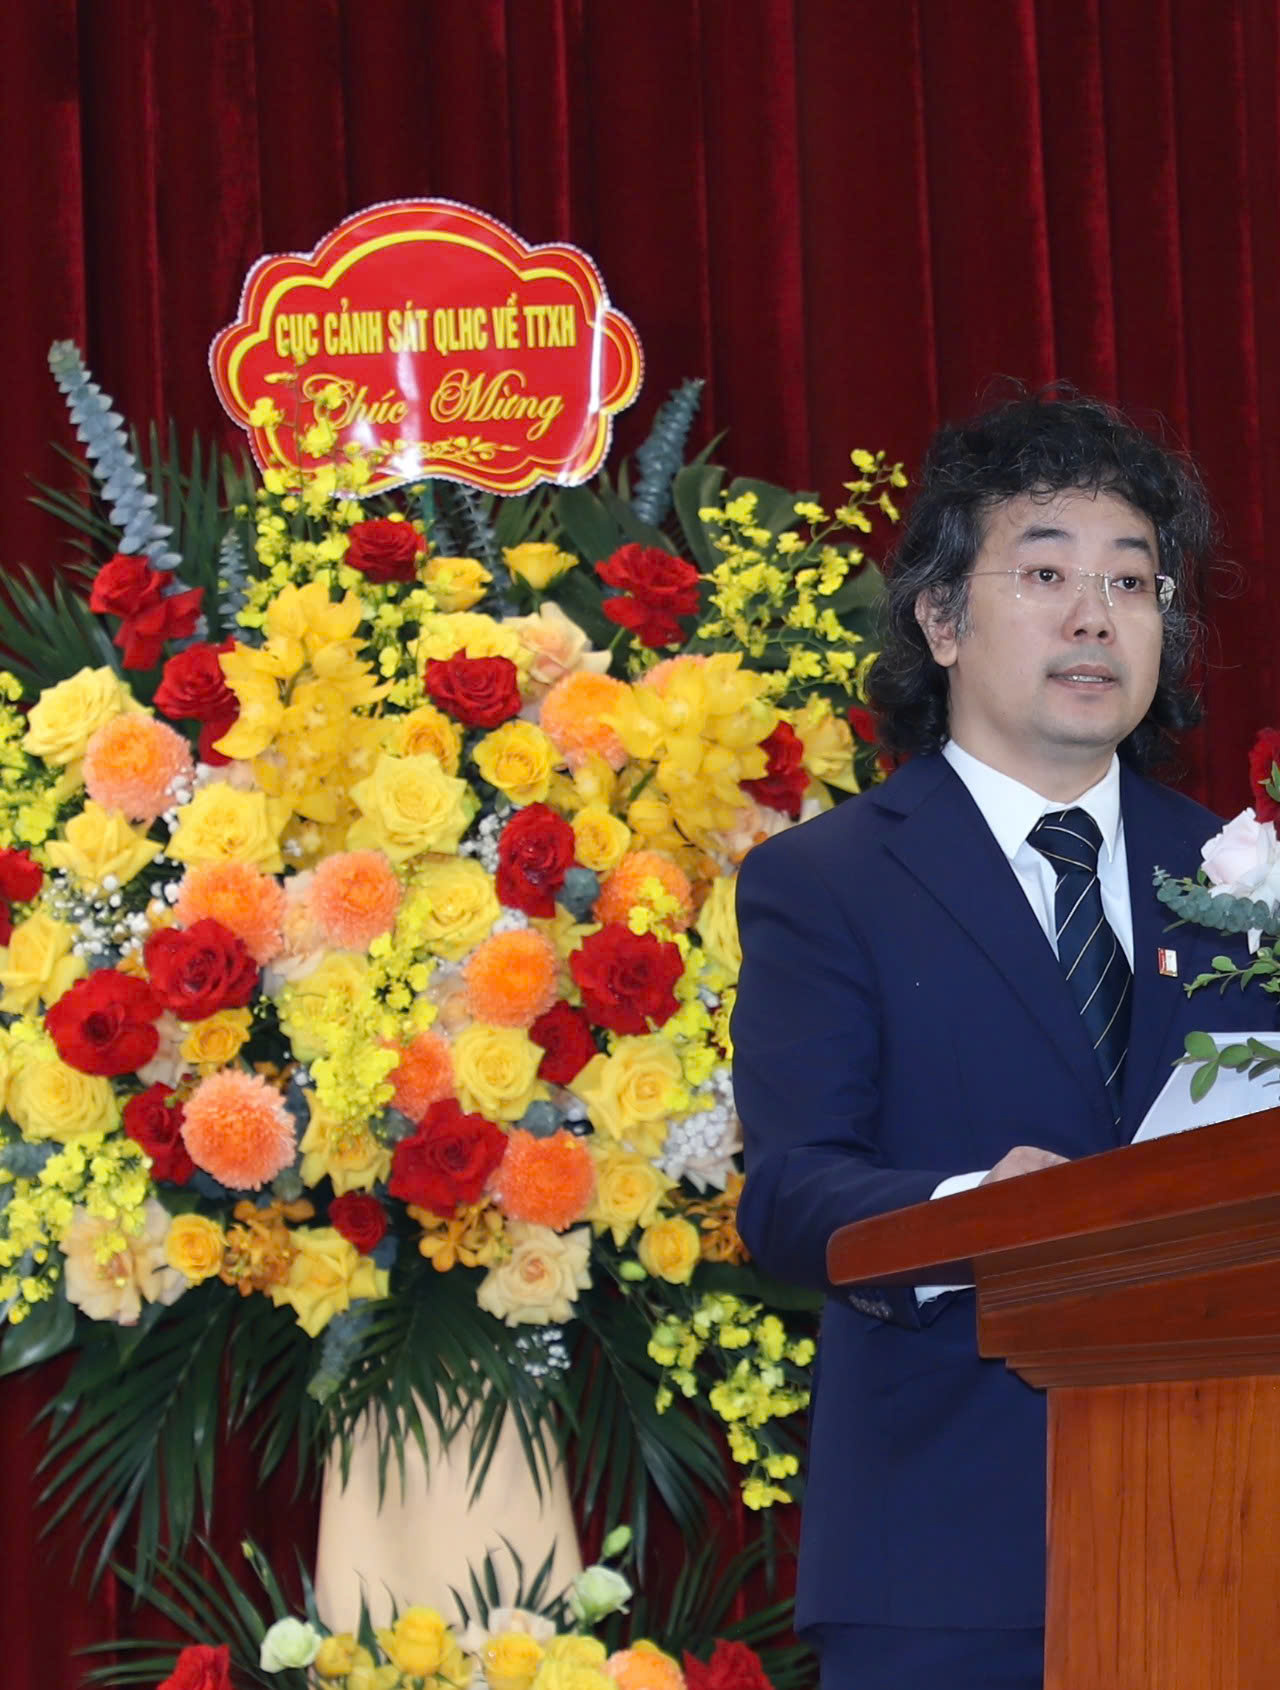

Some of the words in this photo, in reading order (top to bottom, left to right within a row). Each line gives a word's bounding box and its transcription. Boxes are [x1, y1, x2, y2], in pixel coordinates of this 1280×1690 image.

[324, 297, 384, 356] CẢNH
[388, 300, 428, 353] SÁT
[433, 306, 488, 357] QLHC
[523, 304, 577, 348] TTXH
[430, 368, 565, 441] Mừng
